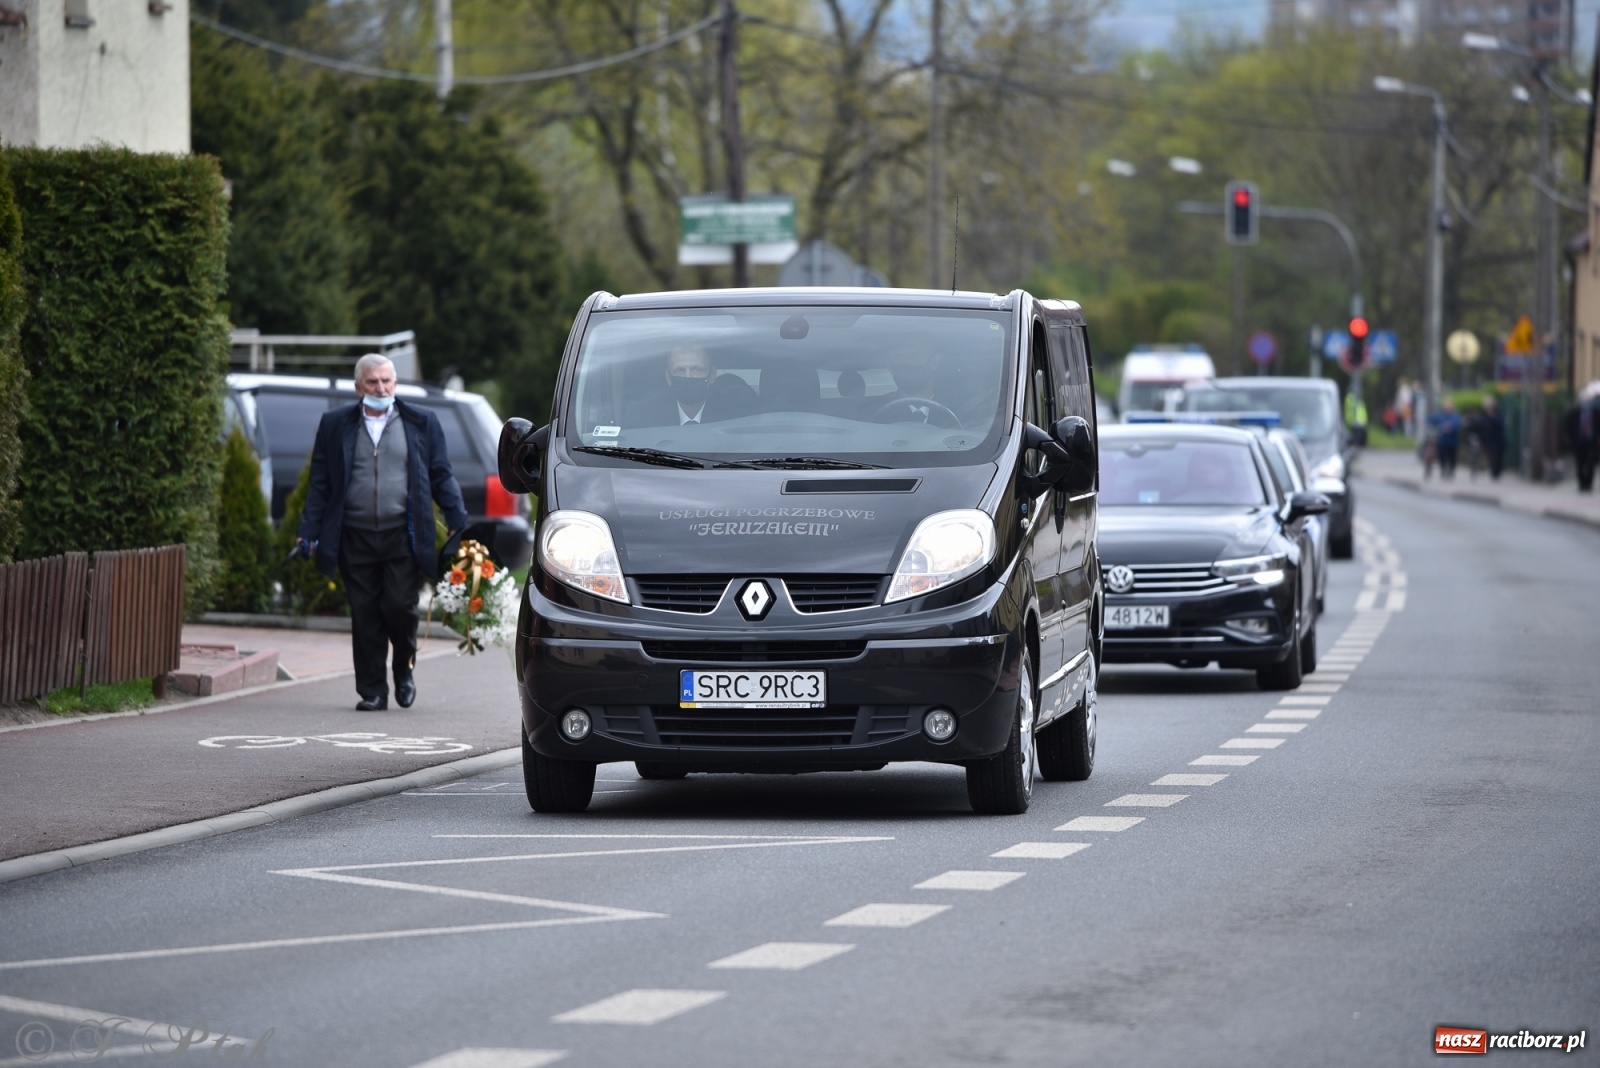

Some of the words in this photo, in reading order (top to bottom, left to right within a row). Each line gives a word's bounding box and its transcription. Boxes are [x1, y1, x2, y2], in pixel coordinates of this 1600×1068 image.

[659, 507, 730, 520] USŁUGI
[735, 507, 876, 520] POGRZEBOWE
[1112, 607, 1165, 625] 4812W
[683, 689, 693, 697] PL
[698, 674, 750, 699] SRC
[759, 674, 820, 699] 9RC3
